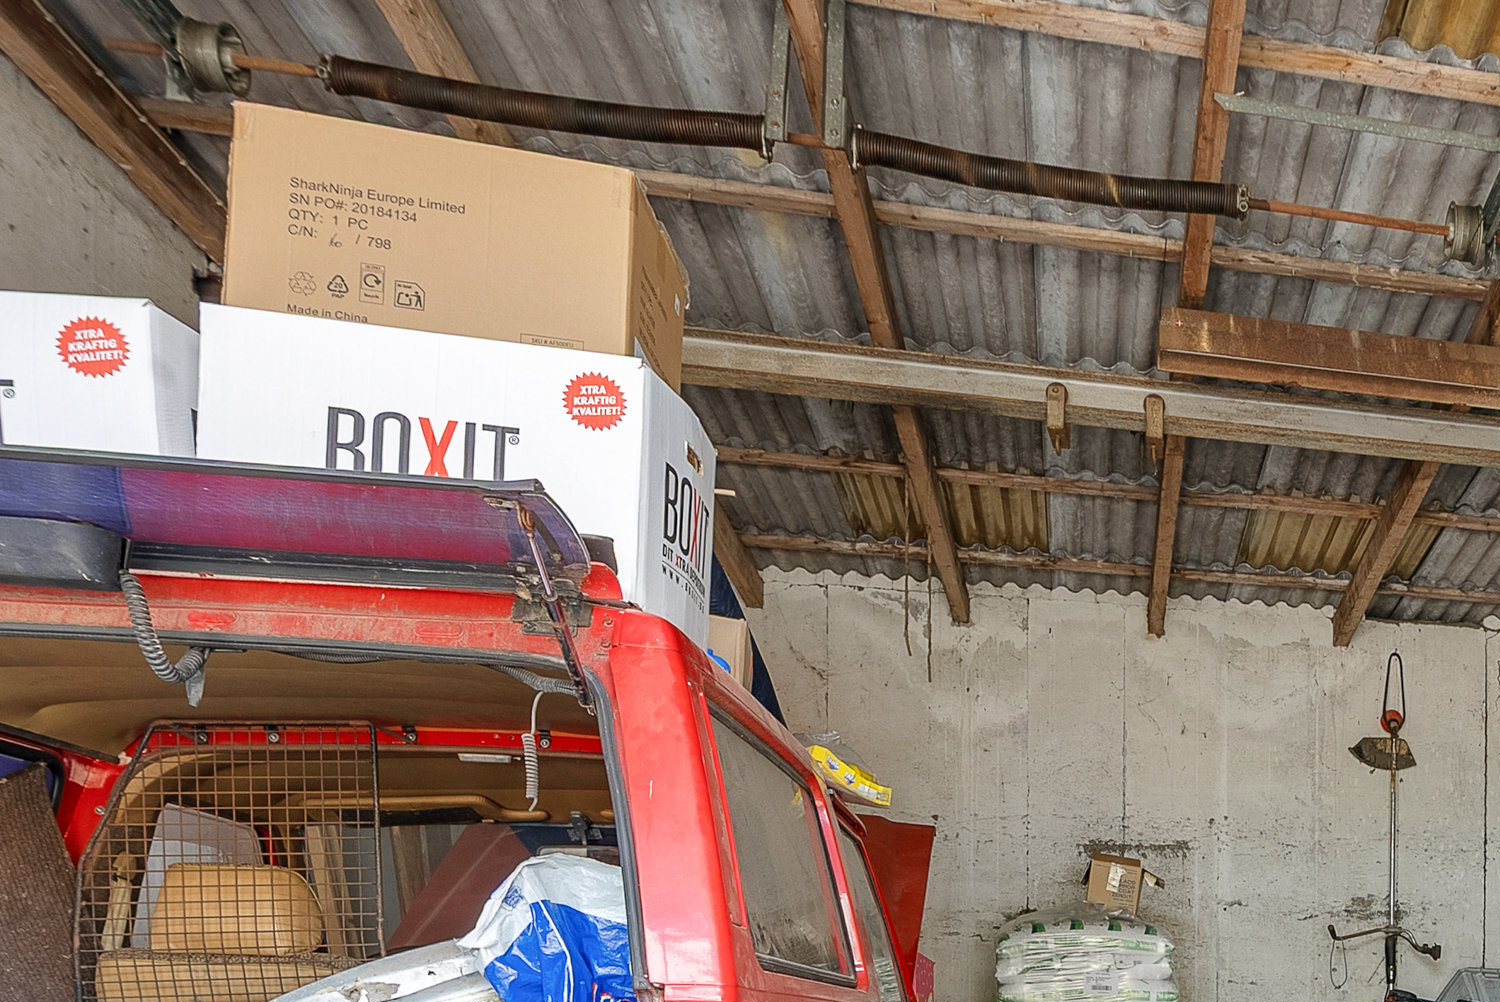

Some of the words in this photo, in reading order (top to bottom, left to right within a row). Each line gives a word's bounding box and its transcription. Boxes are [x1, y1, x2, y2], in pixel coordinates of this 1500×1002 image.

[289, 176, 363, 199] SharkNinja
[367, 188, 415, 206] Europe
[418, 197, 466, 214] Limited
[289, 192, 310, 205] SN
[314, 197, 348, 212] PO#:
[351, 202, 417, 223] 20184134
[288, 208, 323, 224] QTY:
[332, 216, 339, 226] 1
[347, 217, 369, 231] PC
[287, 224, 318, 238] C/N:
[367, 236, 392, 250] 798
[286, 303, 318, 316] Made
[321, 308, 332, 318] in
[334, 310, 369, 324] China
[74, 327, 105, 340] XTRA
[67, 338, 118, 351] KRAFTIG
[67, 350, 124, 364] KVALITET!
[580, 385, 607, 395] XTRA
[573, 396, 616, 406] KRAFTIG
[572, 406, 621, 416] KVALITET!
[663, 461, 710, 580] BOXIT
